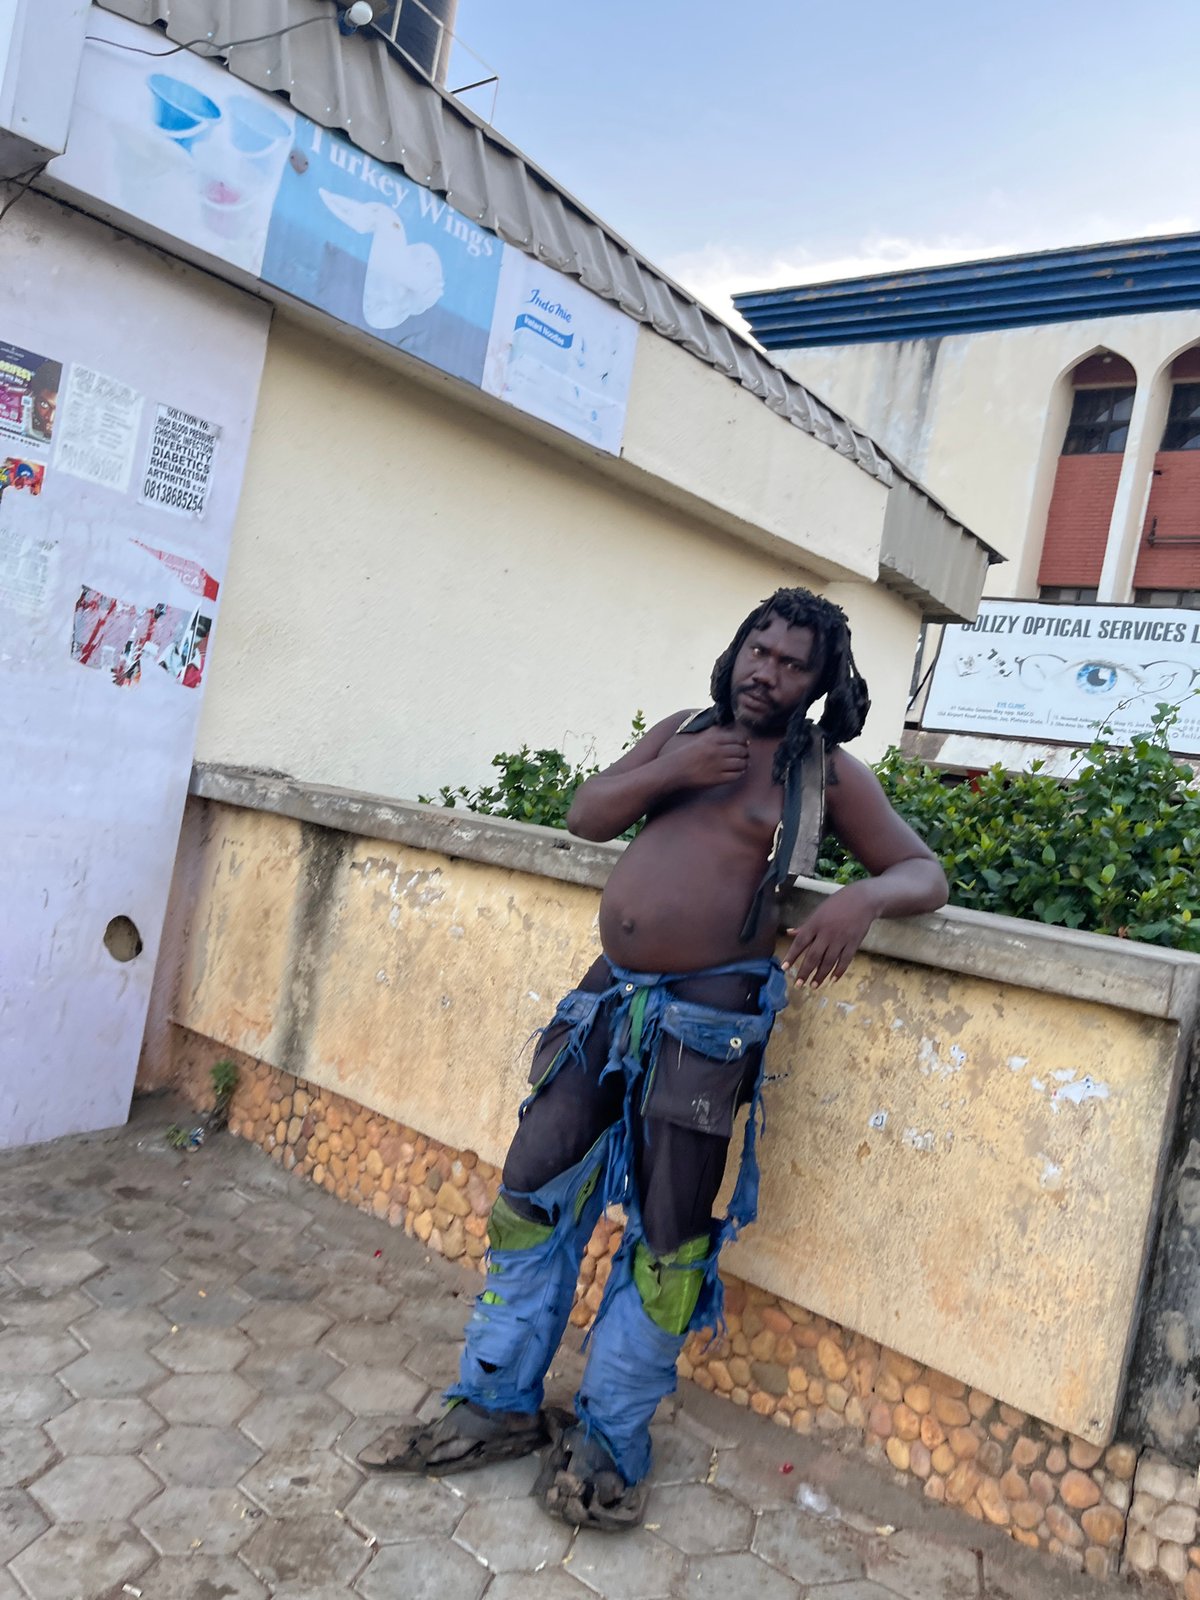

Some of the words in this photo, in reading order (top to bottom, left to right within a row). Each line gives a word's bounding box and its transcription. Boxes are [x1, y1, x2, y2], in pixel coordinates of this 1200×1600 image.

[418, 185, 494, 257] Wings
[158, 415, 171, 428] HIGH
[171, 421, 189, 435] BLOOD
[189, 427, 215, 445] PRESSURE
[167, 407, 197, 426] SOLUTION
[199, 420, 209, 431] TO:
[154, 435, 211, 463] INFERTILITY
[155, 425, 181, 443] CHRONIC
[182, 436, 214, 454] INFECTION
[150, 457, 208, 484] RHEUMATISM
[152, 446, 210, 474] DIABETICS
[147, 467, 191, 489] ARTHRITIS
[144, 479, 204, 513] 08138685254
[1022, 616, 1092, 638] OPTICAL
[1098, 620, 1187, 644] SERVICES
[1008, 702, 1026, 710] CLINIC
